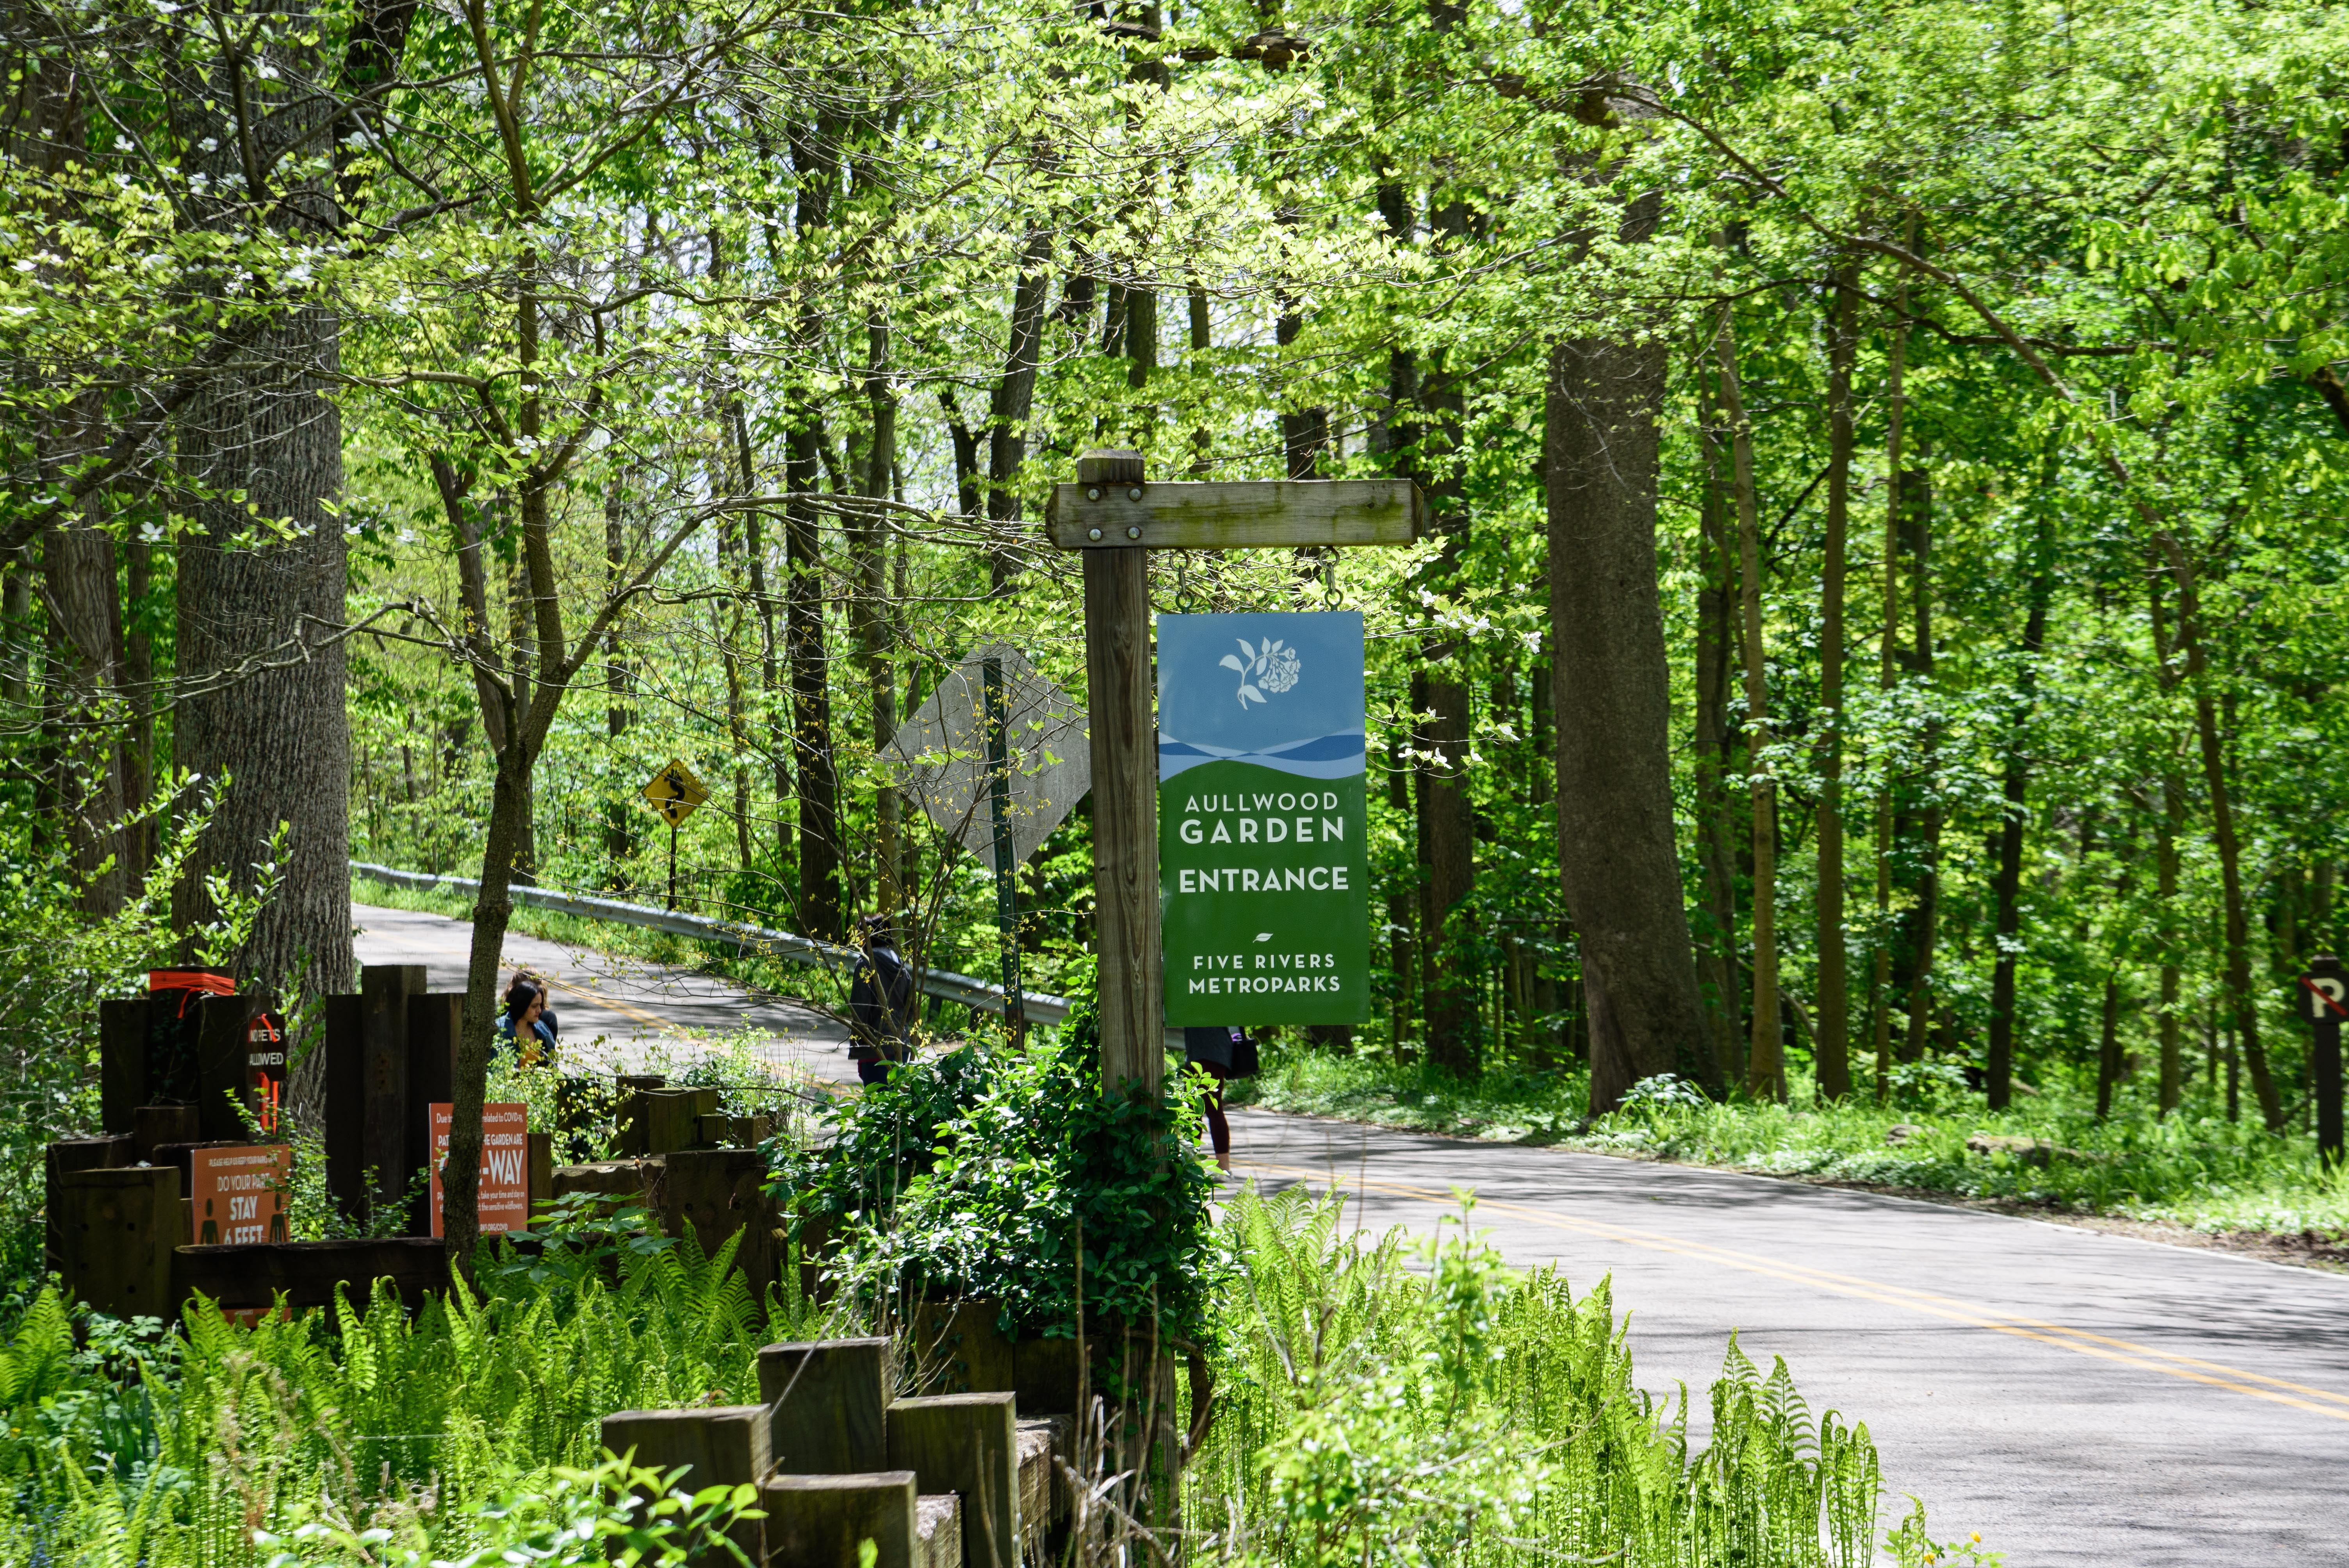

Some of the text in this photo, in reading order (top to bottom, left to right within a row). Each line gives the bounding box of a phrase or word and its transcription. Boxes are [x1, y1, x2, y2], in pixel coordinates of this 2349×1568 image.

[1185, 793, 1338, 812] AULLWOOD
[1180, 817, 1343, 844] GARDEN
[1180, 867, 1349, 893] ENTRANCE
[1194, 954, 1334, 969] FIVE RIVERS
[1189, 976, 1340, 994] METROPARKS
[249, 1053, 283, 1066] ALLOWED
[437, 1113, 447, 1123] Due
[491, 1133, 513, 1146] GARDEN
[513, 1133, 523, 1145] ARE
[217, 1176, 230, 1192] DO
[231, 1174, 251, 1191] YOUR
[230, 1196, 258, 1221] STAY
[224, 1224, 264, 1245] 6 FEET
